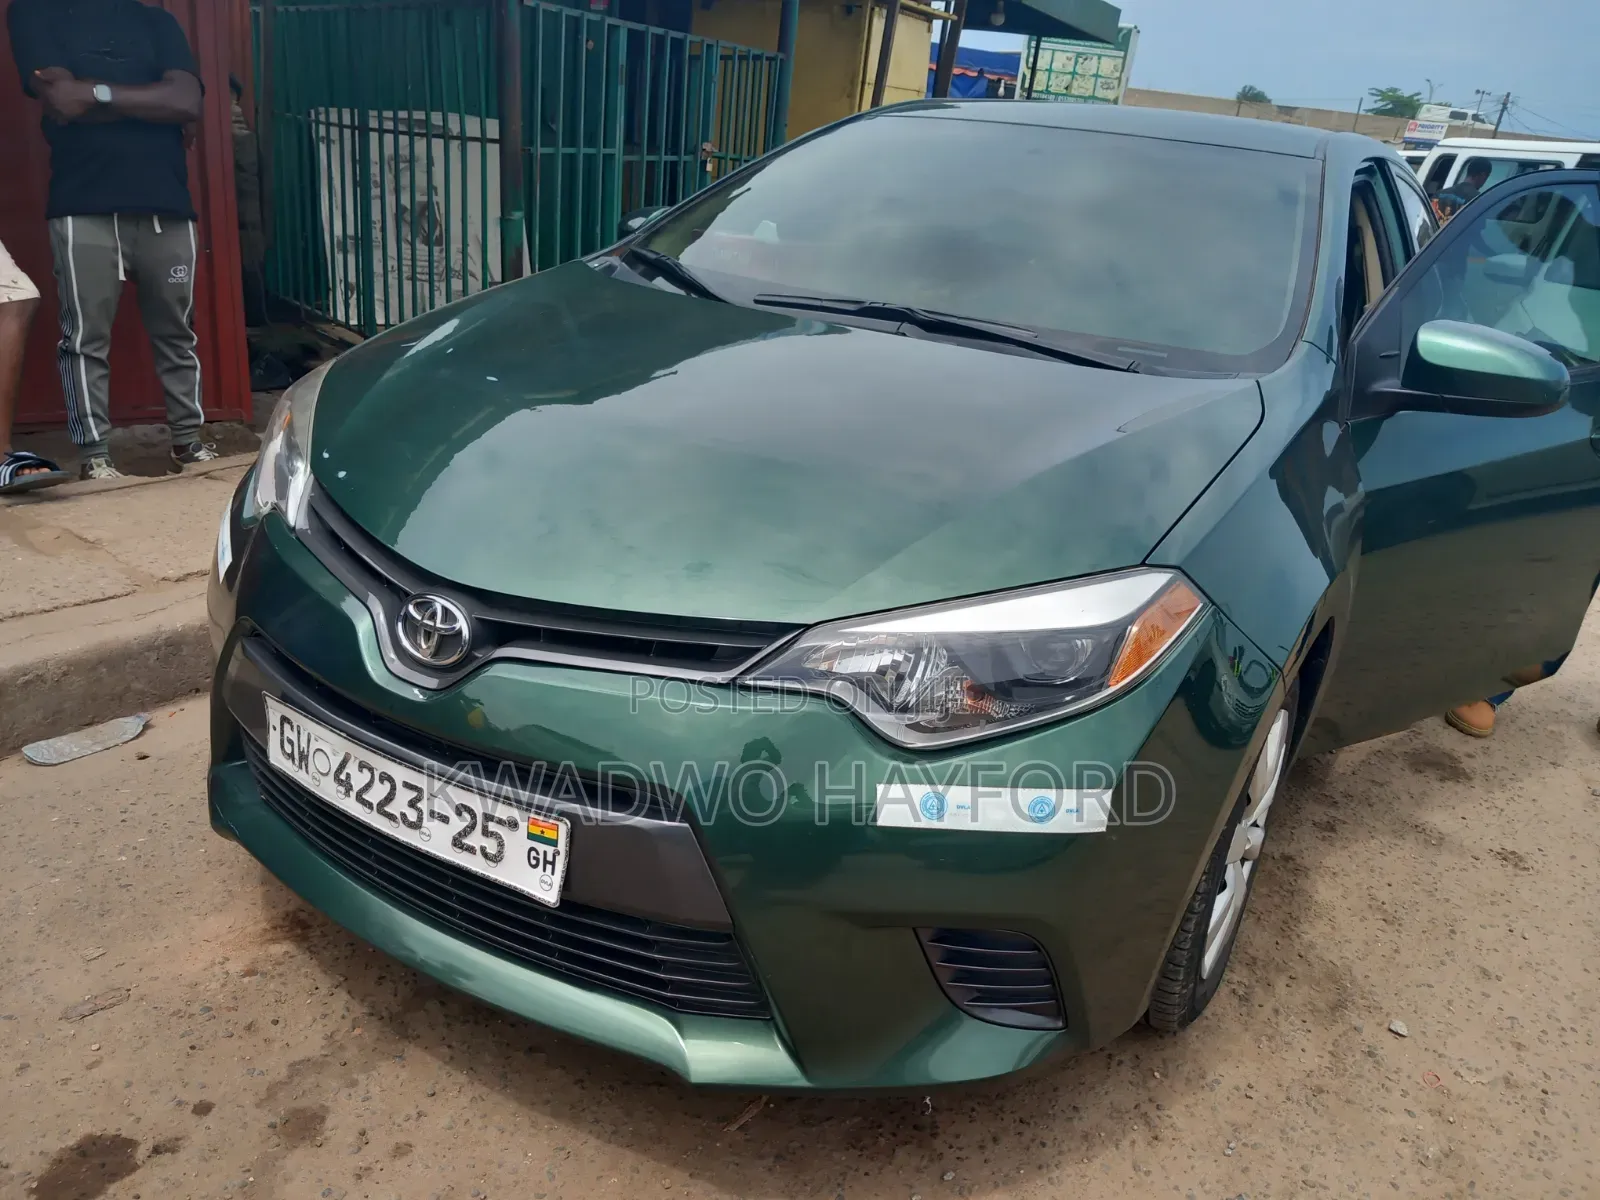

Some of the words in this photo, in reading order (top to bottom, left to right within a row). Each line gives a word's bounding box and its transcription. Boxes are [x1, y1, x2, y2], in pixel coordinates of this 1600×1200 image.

[279, 714, 312, 775] GW
[333, 751, 506, 864] 4223-25
[527, 846, 557, 876] GH
